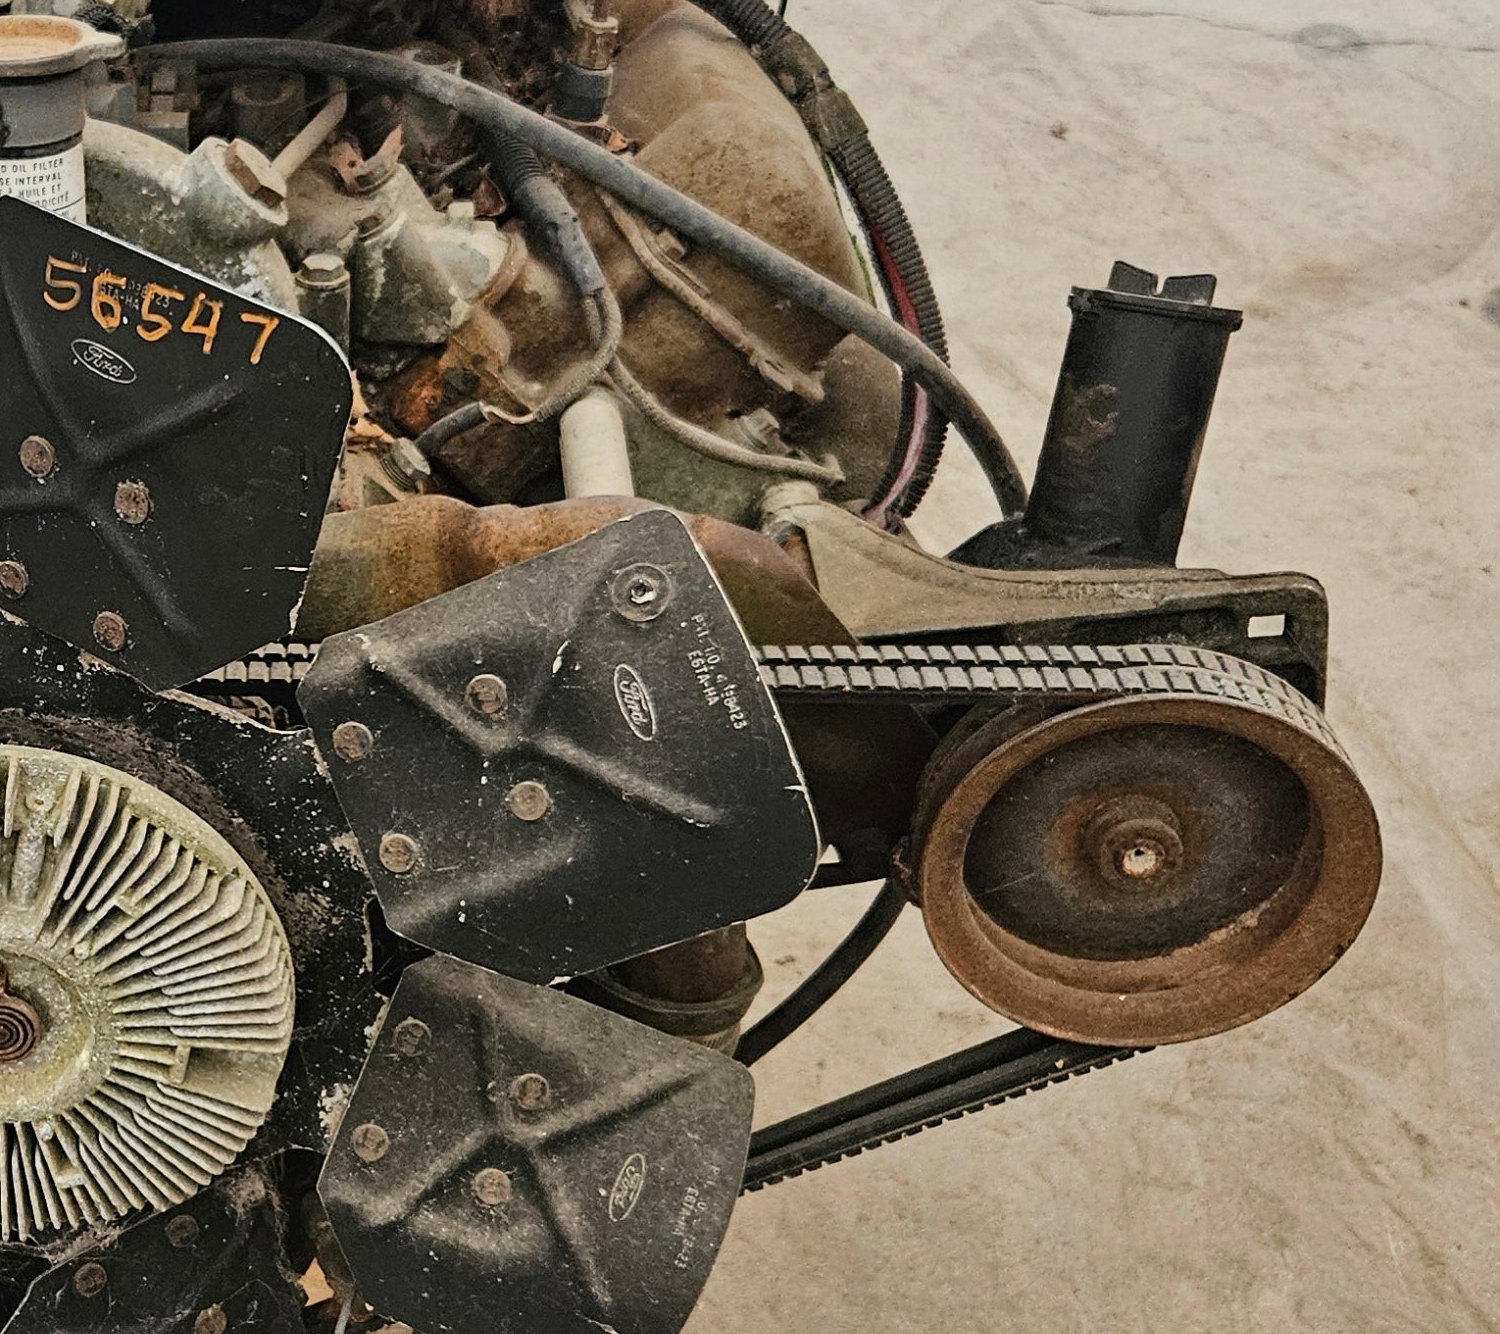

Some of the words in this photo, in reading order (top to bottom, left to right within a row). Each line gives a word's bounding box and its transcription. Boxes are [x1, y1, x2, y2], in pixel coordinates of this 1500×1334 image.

[12, 162, 28, 174] OIL
[33, 157, 64, 172] FILTER
[14, 173, 63, 186] INTERVAL
[18, 186, 49, 198] HUILE
[51, 183, 63, 194] ET
[78, 341, 130, 382] Ford
[686, 651, 721, 707] E6TA-HA
[616, 671, 653, 734] Ford
[611, 1158, 643, 1216] Ford
